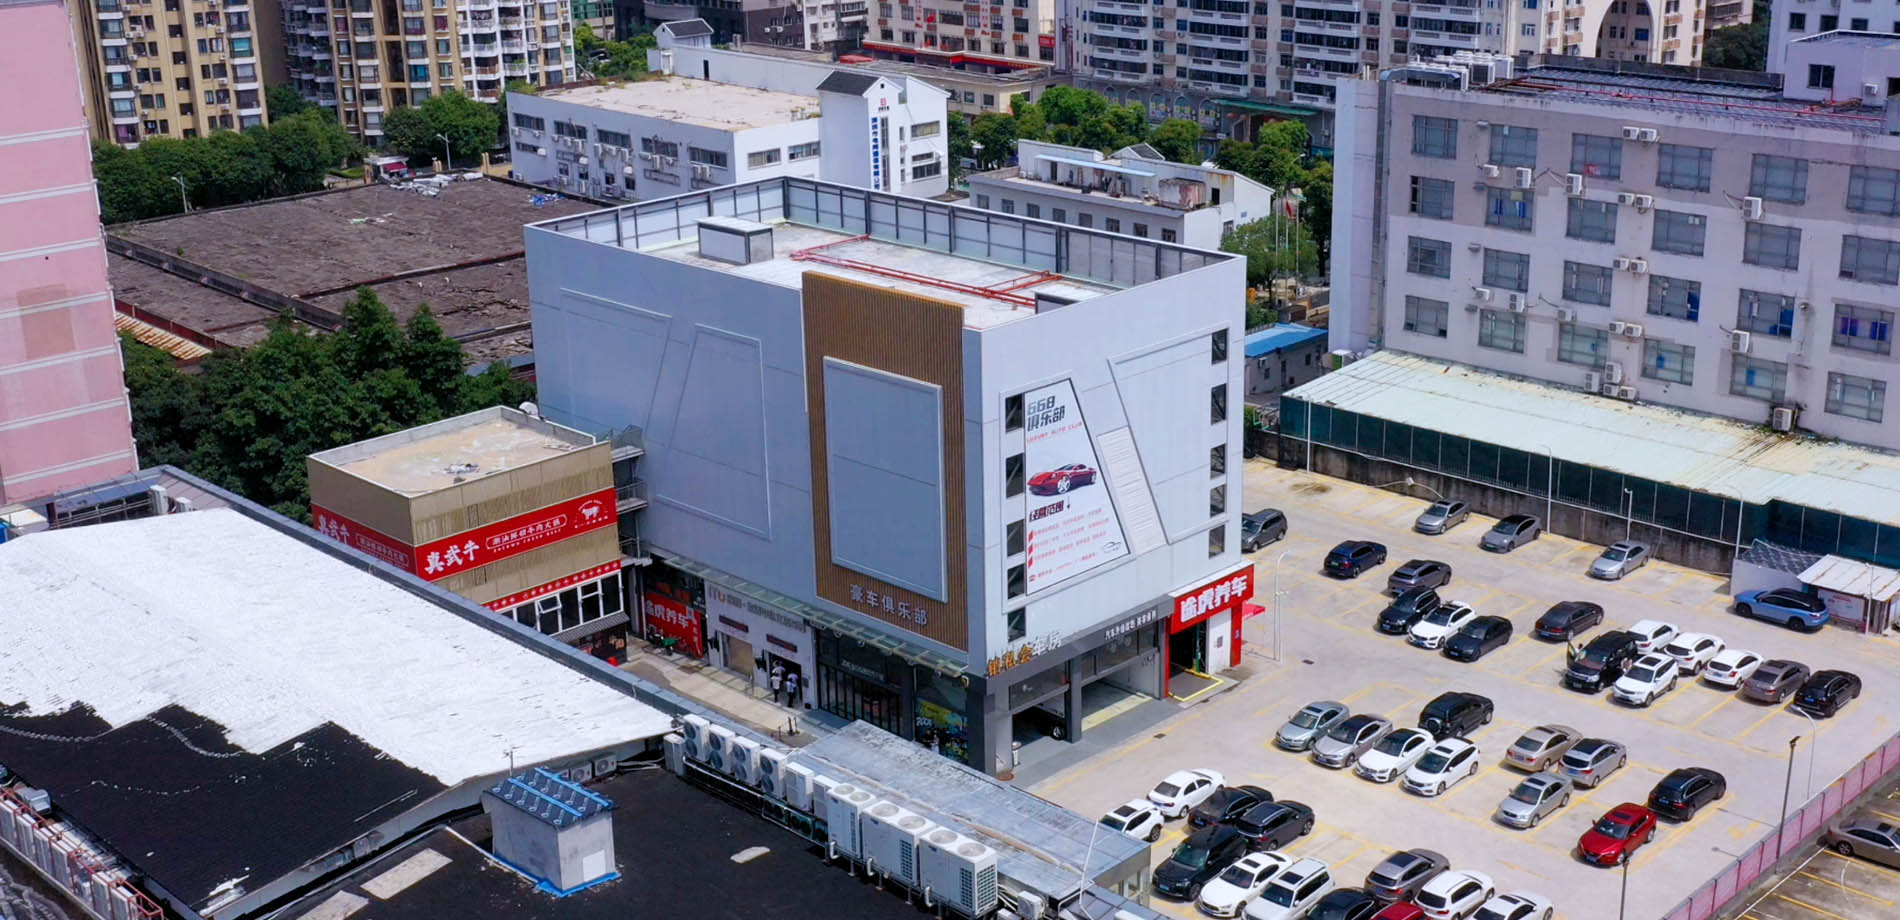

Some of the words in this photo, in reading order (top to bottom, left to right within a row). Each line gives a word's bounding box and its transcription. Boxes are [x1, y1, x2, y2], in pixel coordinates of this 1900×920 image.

[1027, 395, 1056, 416] 668
[1027, 405, 1066, 432] 俱乐部
[424, 539, 480, 575] 真武牛
[850, 584, 928, 626] 豪车俱乐部
[1180, 575, 1248, 623] 途虎养车
